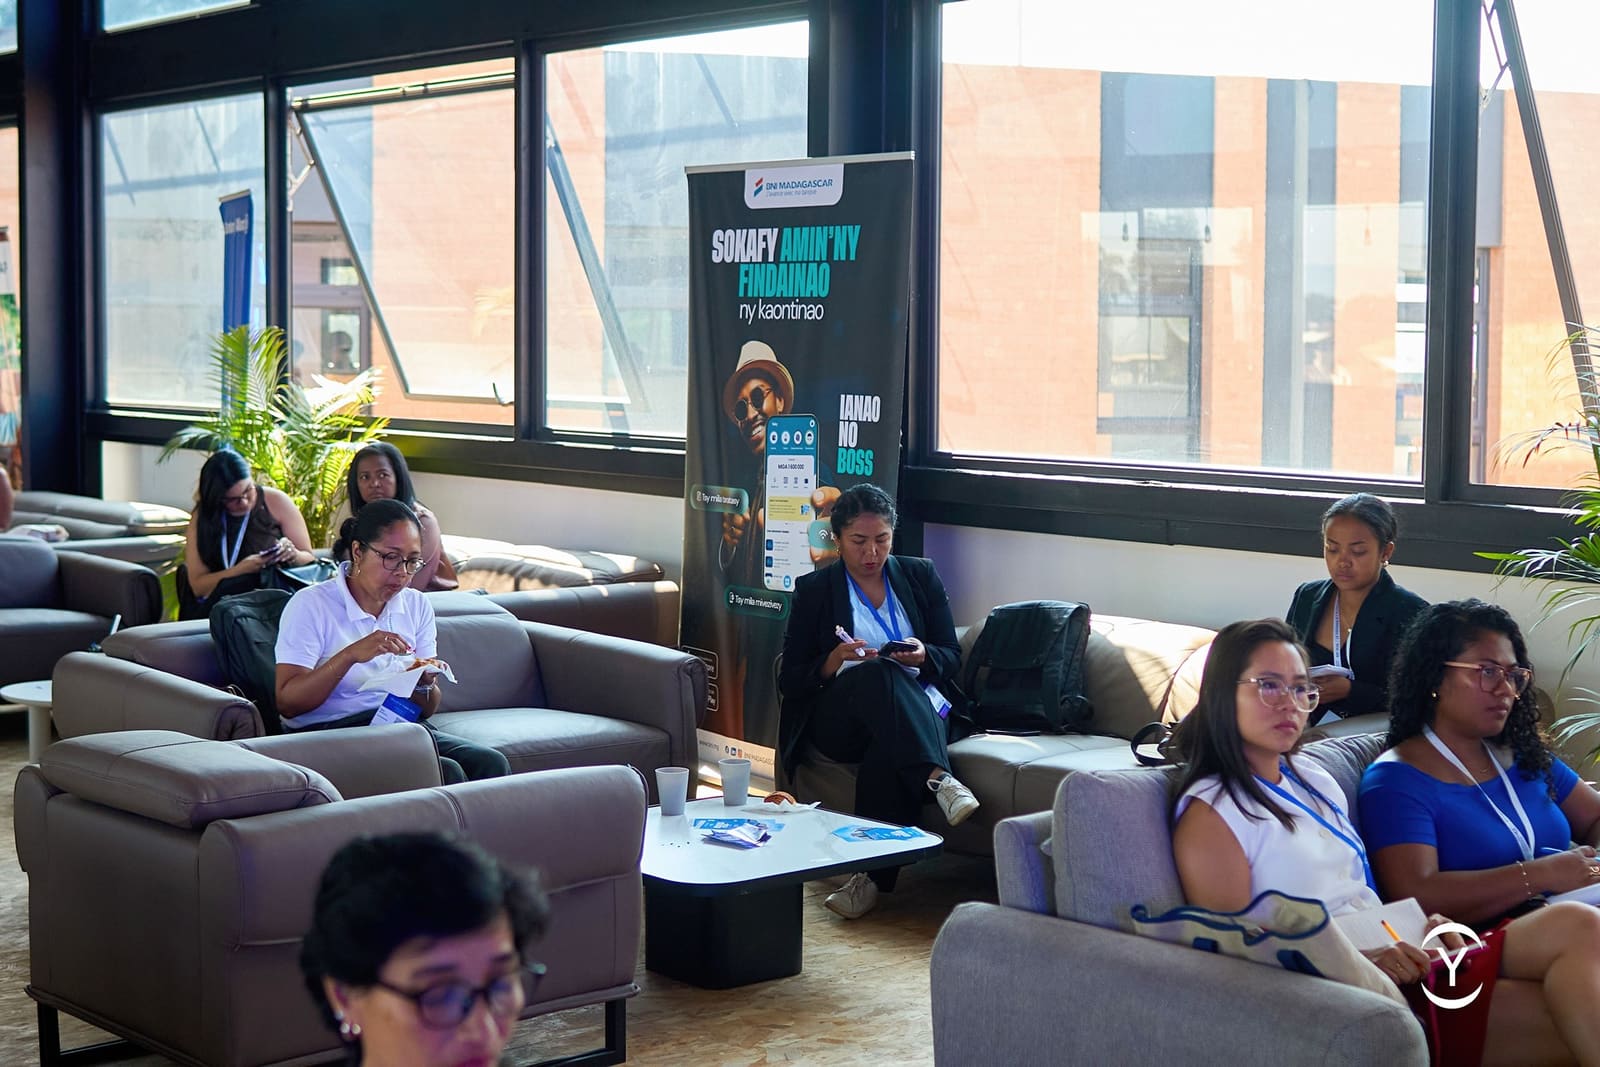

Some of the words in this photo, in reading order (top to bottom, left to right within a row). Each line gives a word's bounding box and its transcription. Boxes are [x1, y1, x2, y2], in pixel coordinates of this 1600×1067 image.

[765, 182, 778, 191] BNI
[779, 179, 833, 190] MADAGASCAR
[712, 227, 779, 263] SOKAFY
[780, 225, 861, 262] AMIN'NY
[738, 263, 830, 297] FINDAINAO
[740, 303, 757, 325] ny
[759, 298, 824, 320] kaontinao
[839, 394, 881, 423] IANAO
[838, 421, 858, 448] NO
[837, 447, 874, 476] BOSS
